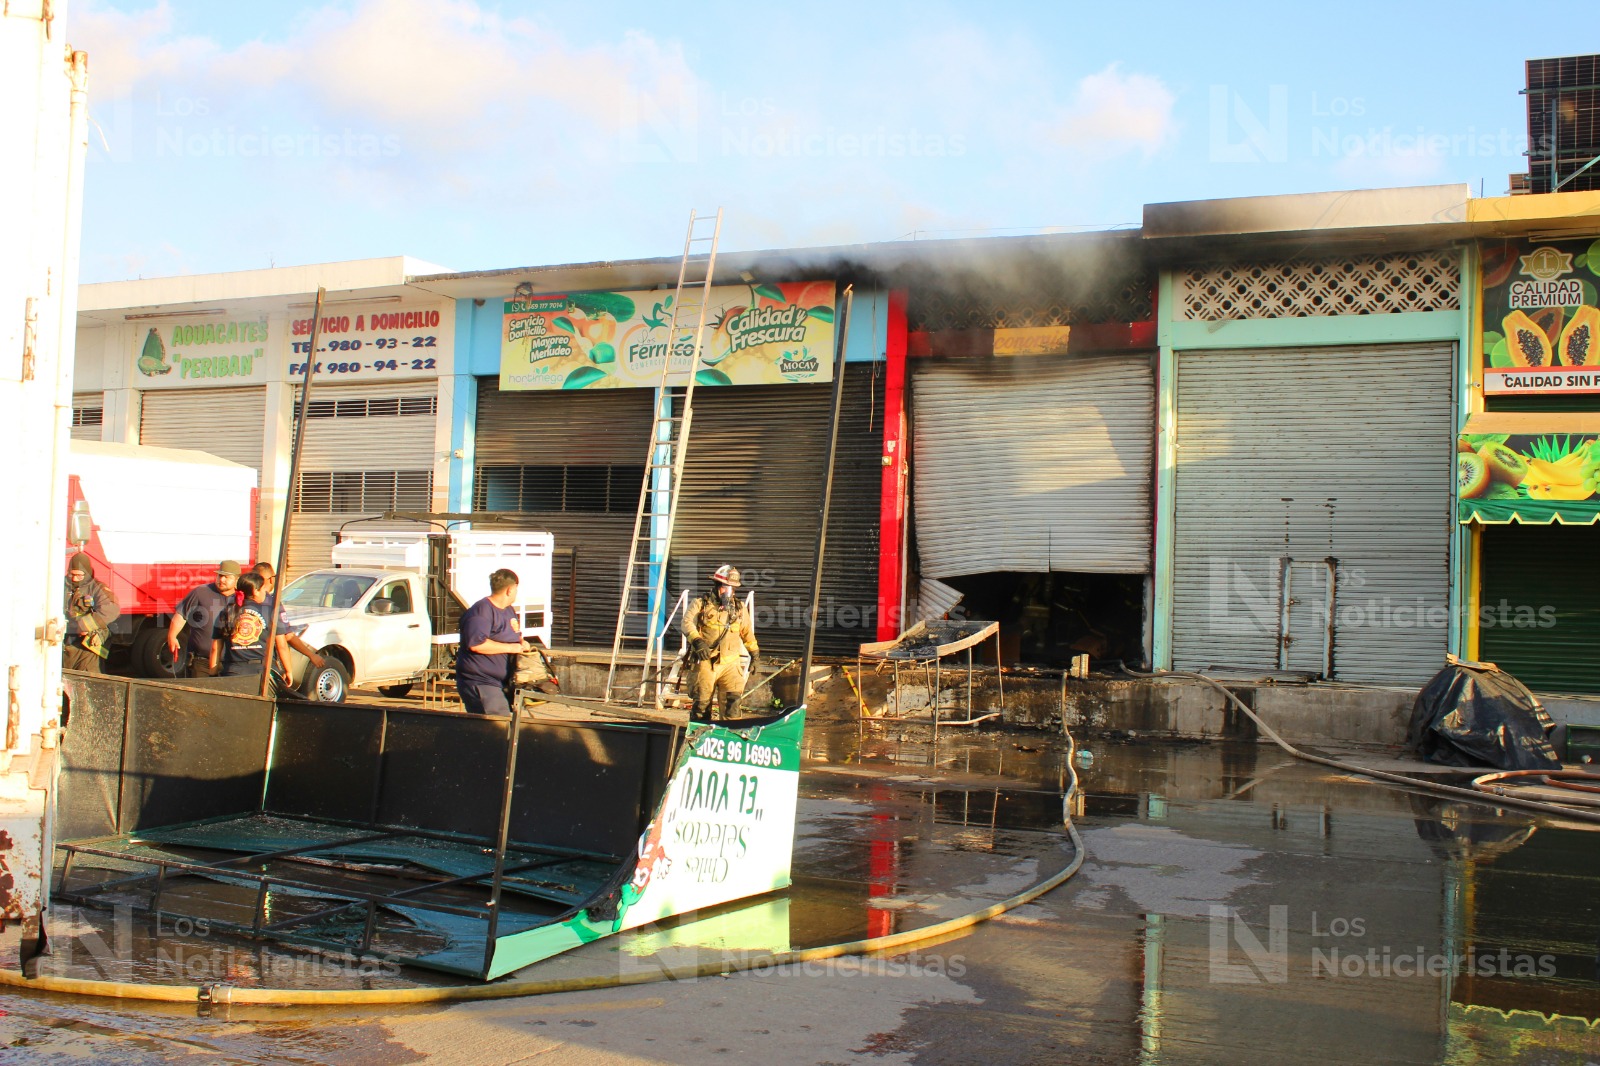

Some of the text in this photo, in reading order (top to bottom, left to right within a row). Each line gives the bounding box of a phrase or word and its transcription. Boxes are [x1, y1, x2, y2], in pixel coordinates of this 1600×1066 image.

[1512, 281, 1580, 295] CALIDAD
[1511, 293, 1581, 307] PREMIUM
[355, 314, 365, 331] A
[371, 310, 440, 330] DOMICILIO
[509, 315, 545, 331] Servicio
[726, 304, 808, 335] Calidad y
[171, 319, 269, 347] AGUACATES
[509, 326, 547, 342] Domicilio
[531, 335, 570, 351] Mayoreo
[731, 325, 806, 353] Frescura
[530, 346, 572, 363] Menudeo
[1566, 375, 1590, 387] SIN
[727, 740, 741, 762] 96
[745, 742, 771, 766] 6691
[673, 821, 750, 859] Selectos
[685, 857, 729, 883] Chiles
